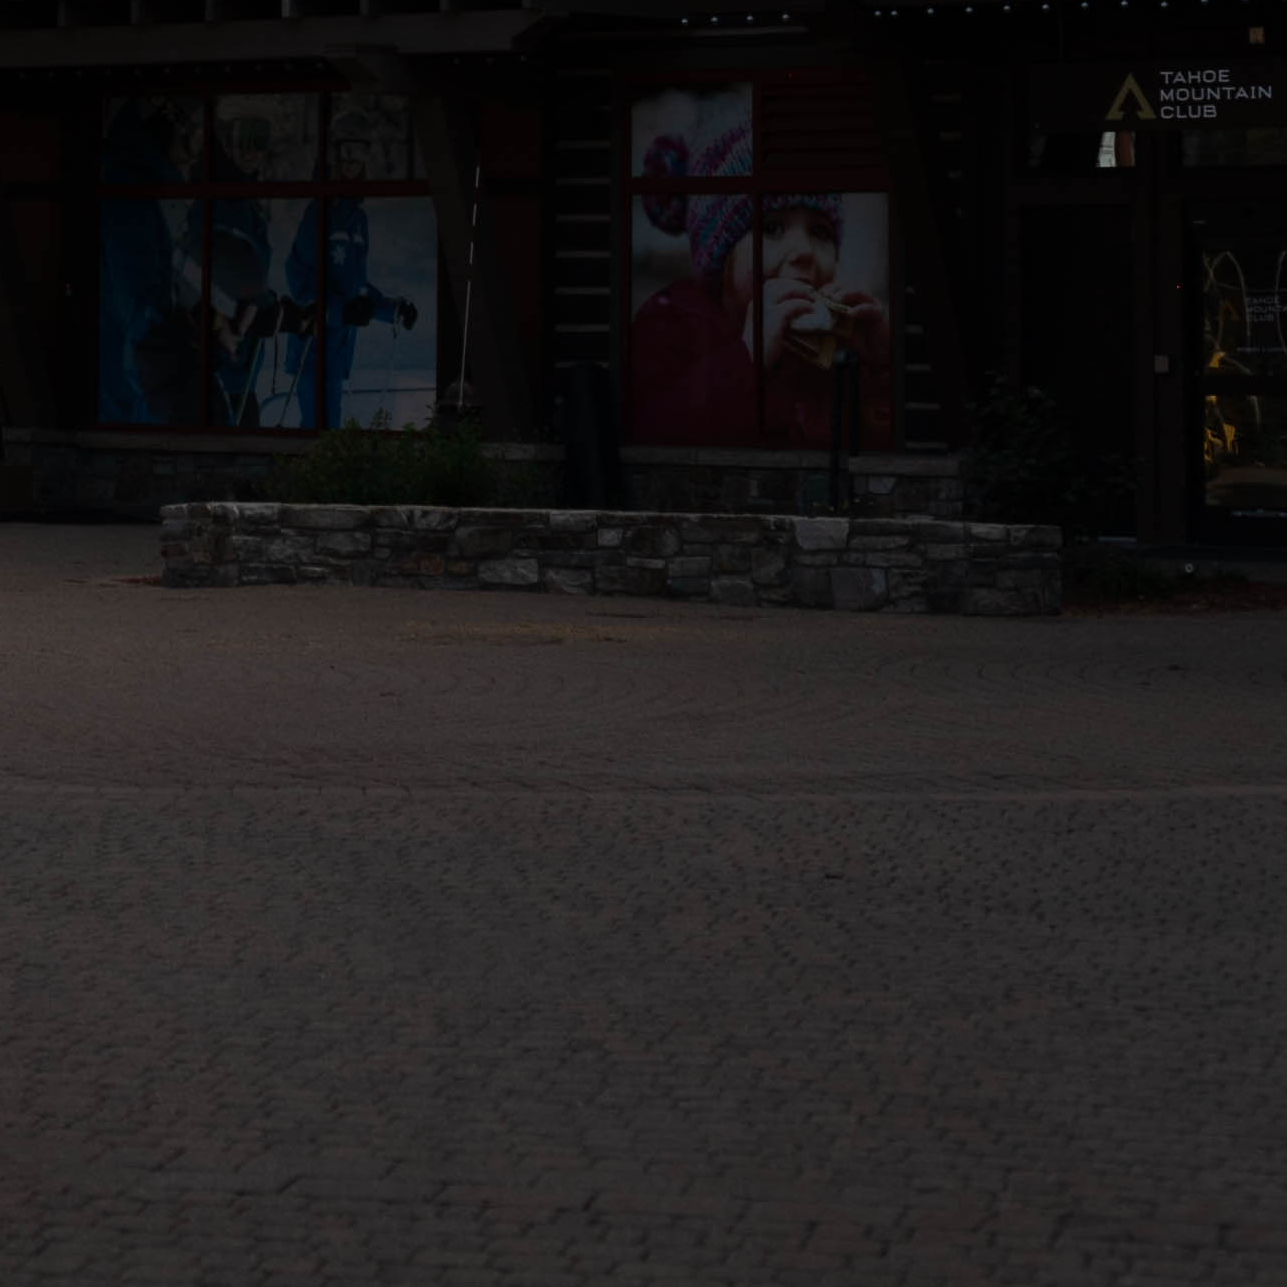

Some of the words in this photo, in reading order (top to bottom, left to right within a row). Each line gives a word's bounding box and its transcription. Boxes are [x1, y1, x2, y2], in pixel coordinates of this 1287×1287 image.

[1159, 68, 1231, 84] TAHOE
[1159, 84, 1273, 101] MOUNTAIN
[1159, 104, 1218, 120] CLUB
